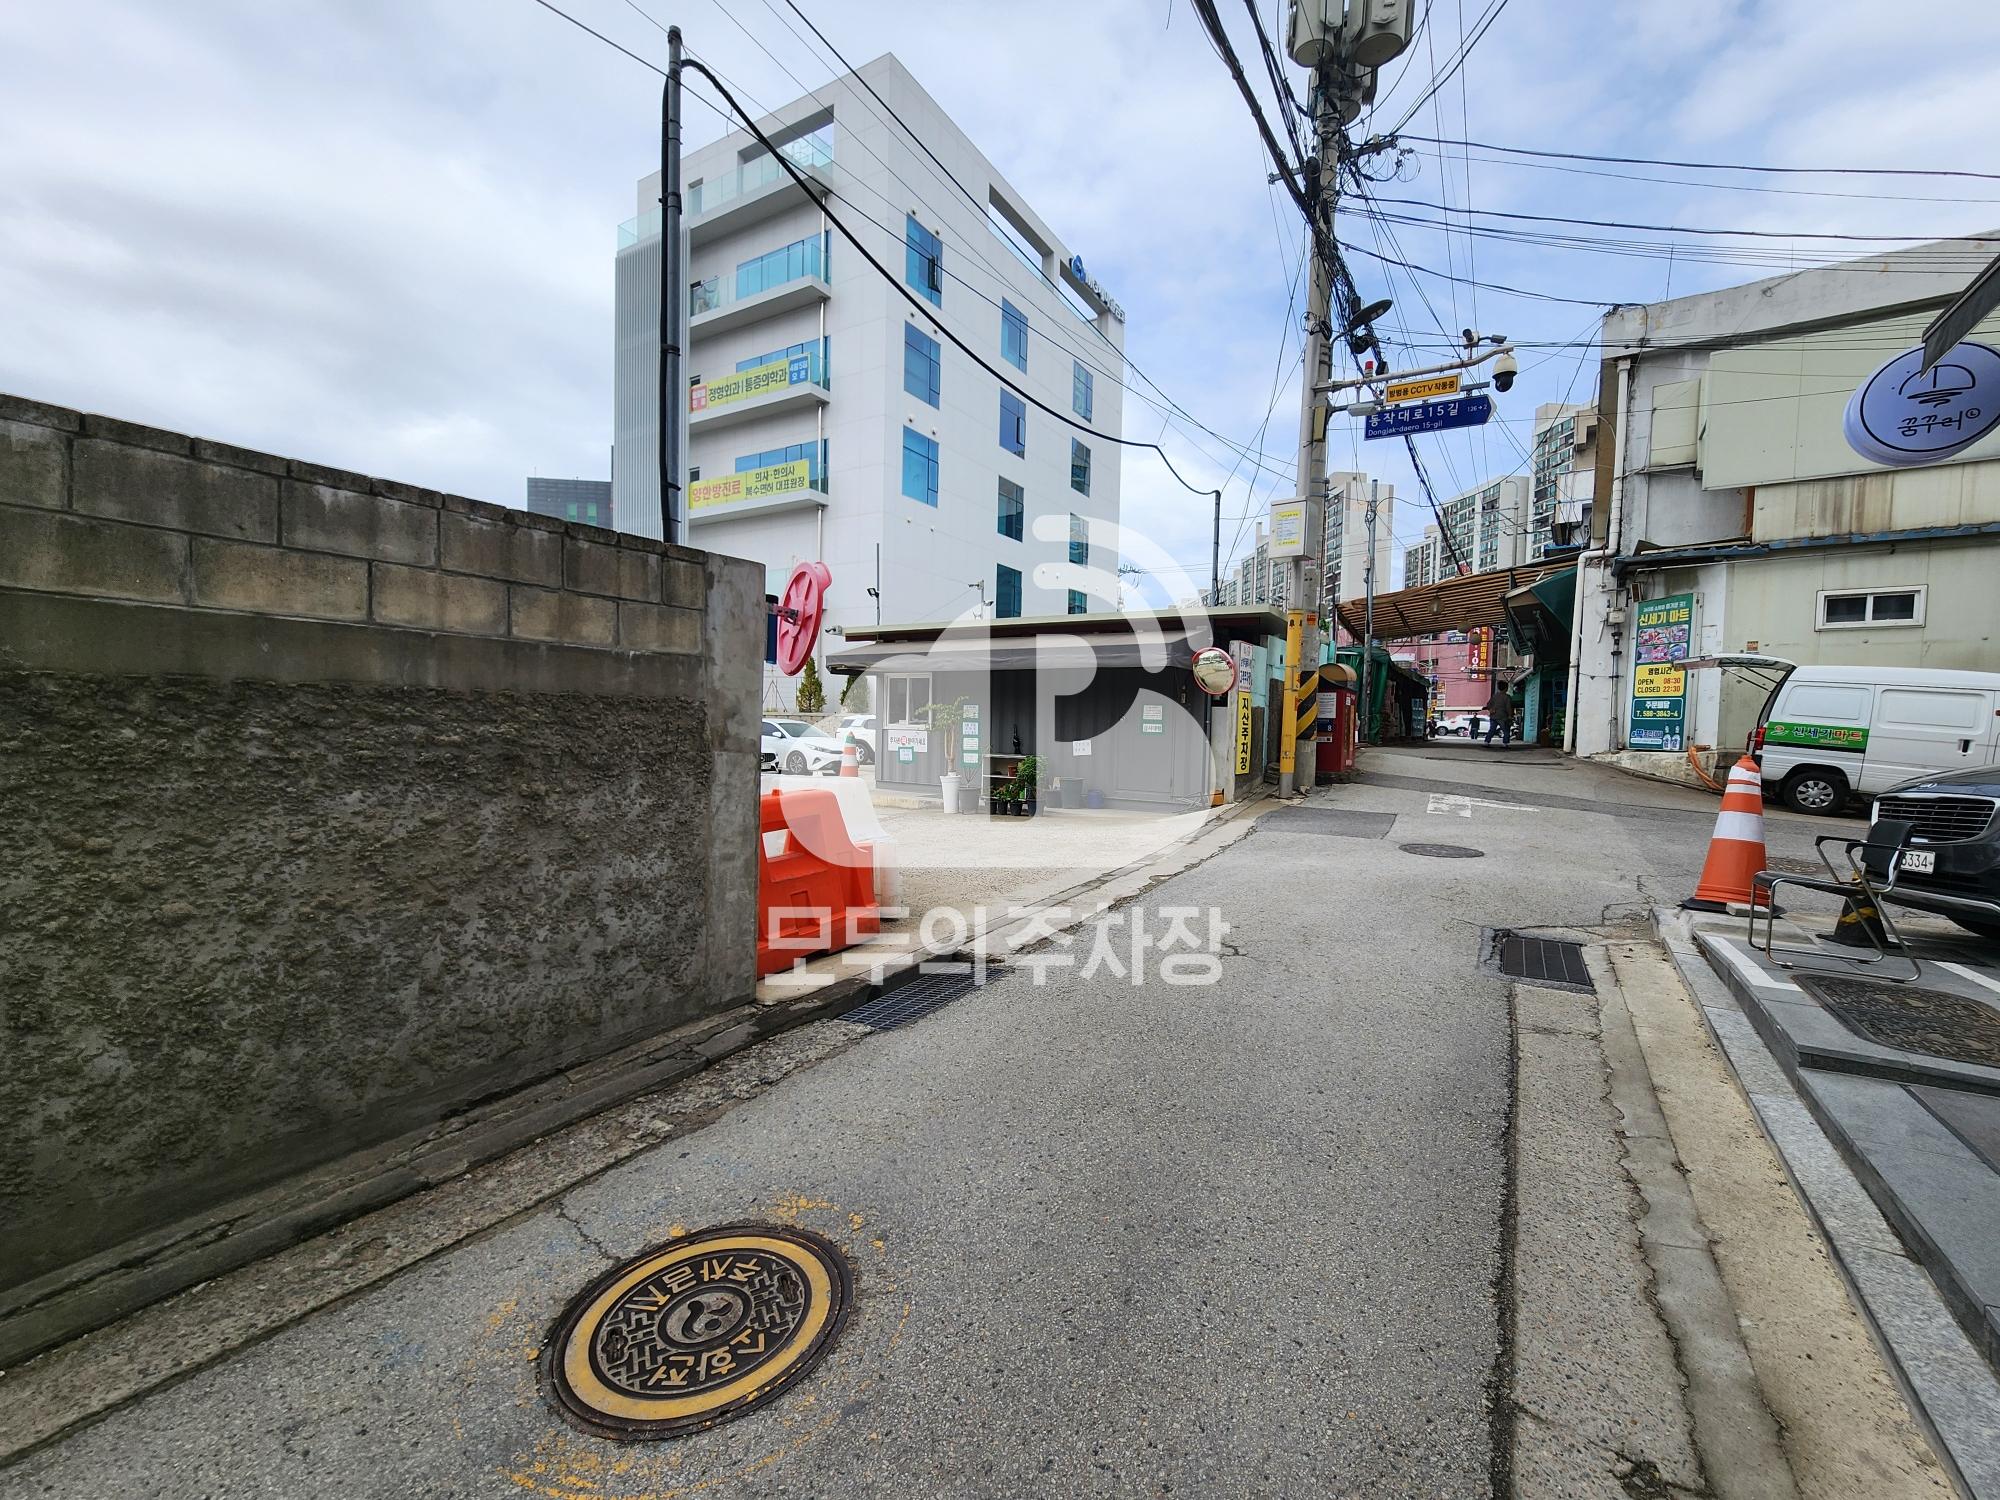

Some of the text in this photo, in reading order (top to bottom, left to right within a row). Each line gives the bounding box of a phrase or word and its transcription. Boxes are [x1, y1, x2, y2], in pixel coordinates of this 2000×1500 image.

[708, 382, 740, 402] 정형외과
[745, 367, 787, 392] 통증의학과
[1410, 385, 1433, 395] CCTV
[1368, 401, 1459, 427] 동작대로15길
[1368, 421, 1443, 437] Dongjak-daero 15-gil
[1639, 608, 1690, 626] 신세기 마트
[1663, 685, 1681, 693] 22:30
[1240, 696, 1250, 771] 지산주차장
[1792, 725, 1863, 741] 신세기마트
